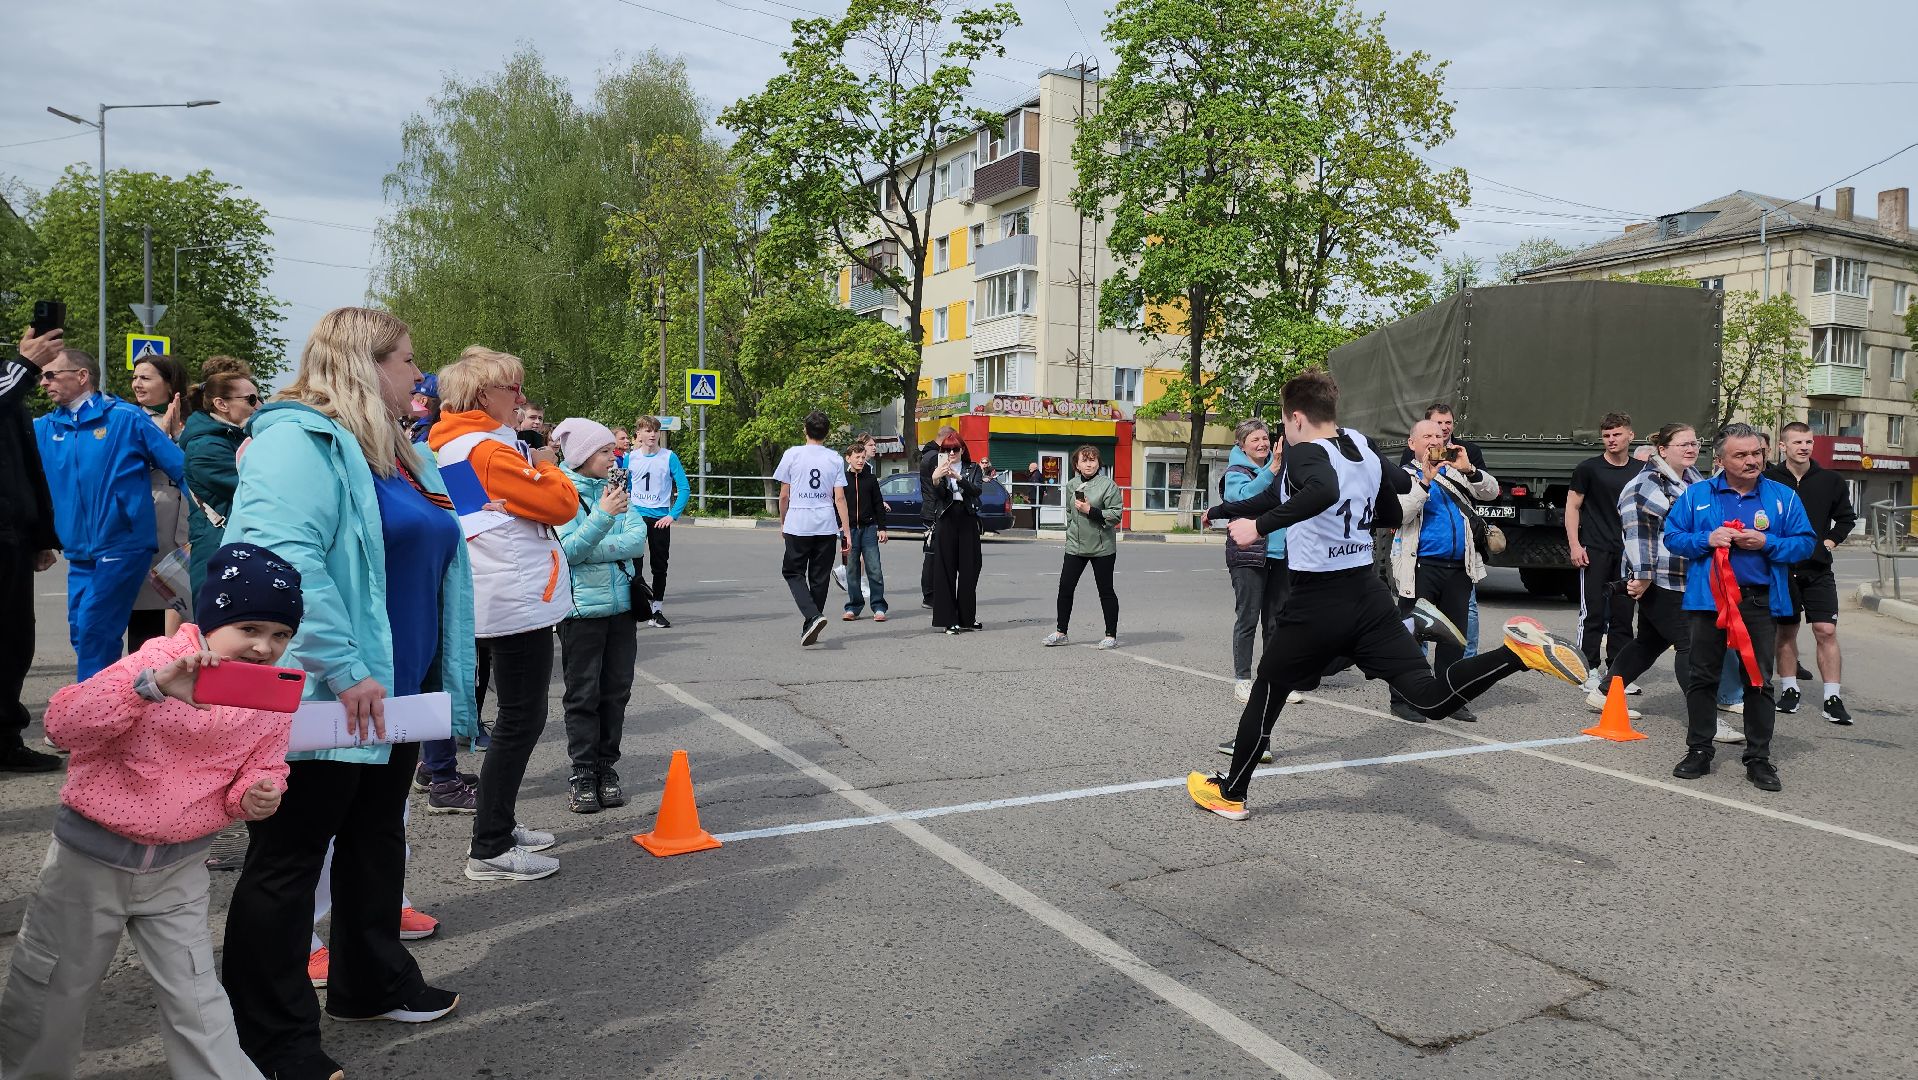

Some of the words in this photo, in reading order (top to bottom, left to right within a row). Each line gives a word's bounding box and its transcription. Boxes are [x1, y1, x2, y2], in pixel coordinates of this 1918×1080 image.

[993, 398, 1044, 415] ОВОЩИ
[1056, 401, 1113, 416] ФРУКТЫ
[641, 472, 651, 491] 1
[809, 468, 821, 489] 8
[1336, 497, 1373, 539] 14
